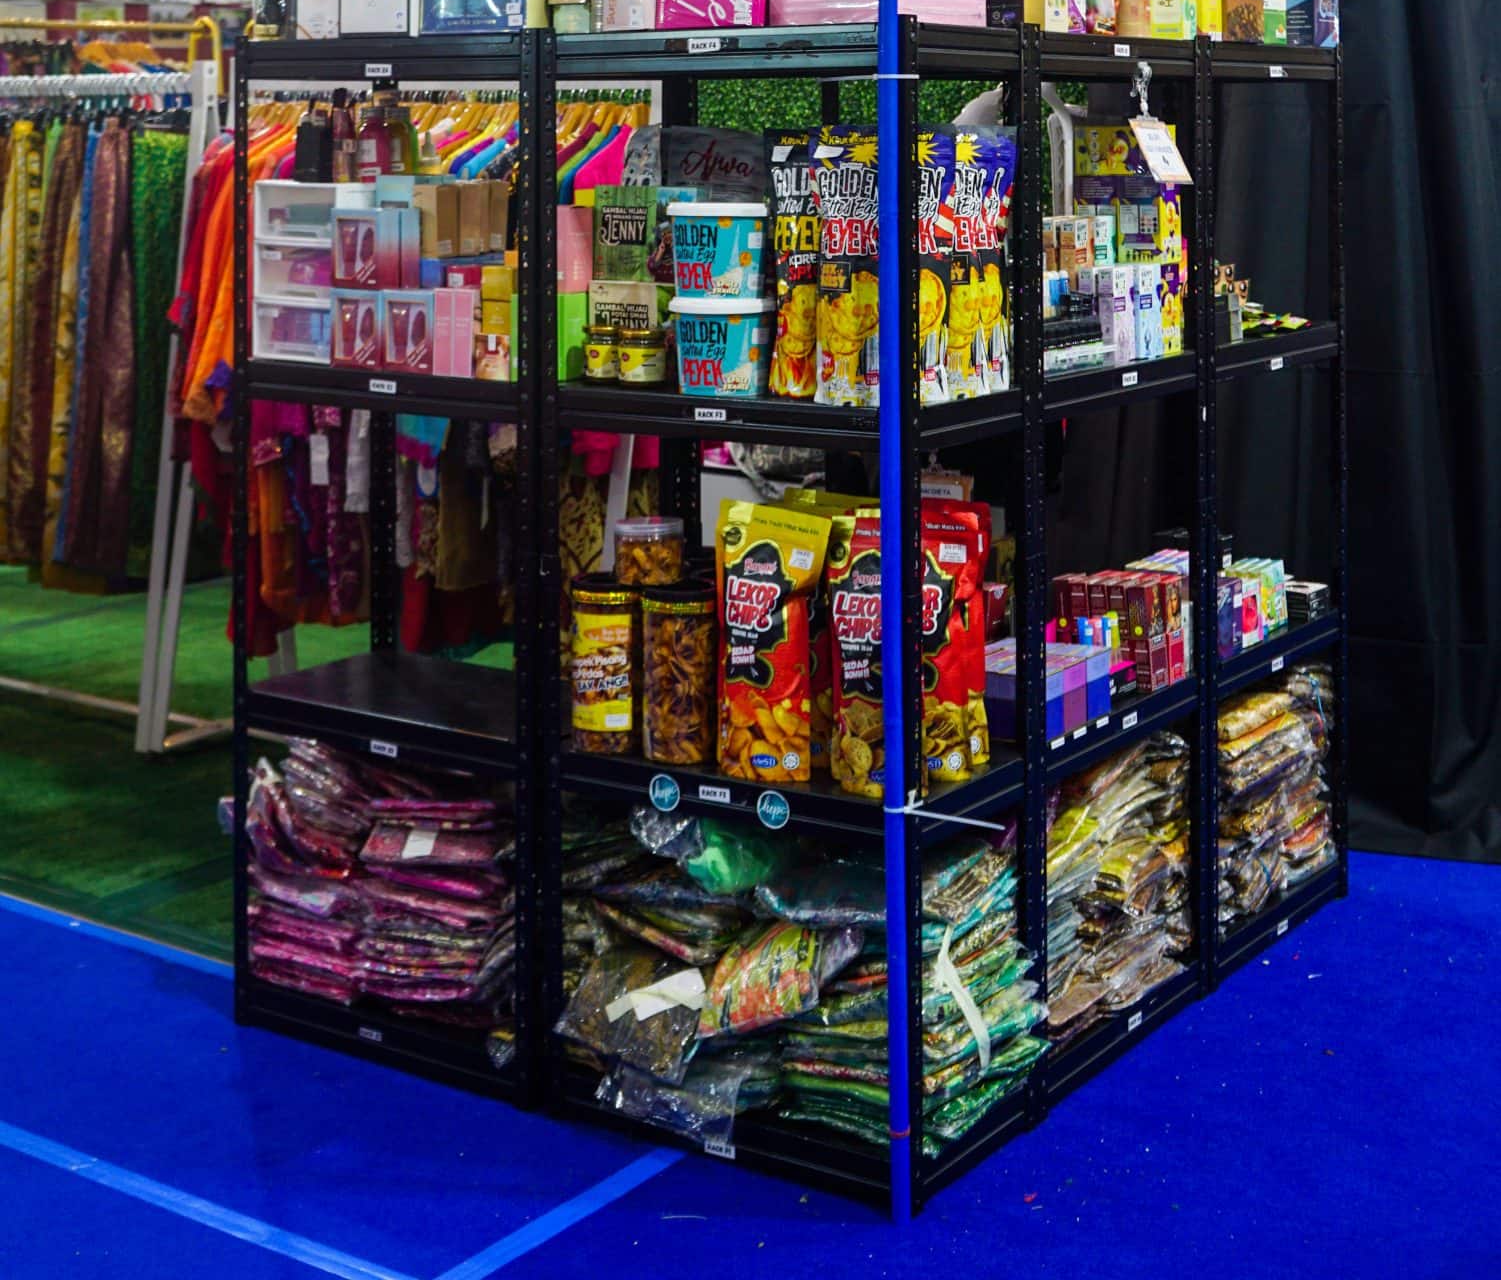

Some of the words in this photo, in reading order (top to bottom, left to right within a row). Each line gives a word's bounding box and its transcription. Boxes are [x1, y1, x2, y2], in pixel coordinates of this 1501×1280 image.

[690, 40, 708, 50] RACK
[680, 139, 755, 182] Ajwa
[772, 166, 811, 198] GOLD
[600, 214, 646, 246] JENNY
[680, 320, 728, 346] GOLDEN
[697, 411, 714, 419] RACK
[728, 577, 779, 612] LEKOR
[834, 592, 882, 618] LEKO
[727, 600, 770, 631] CHIPS
[701, 789, 717, 797] RACK
